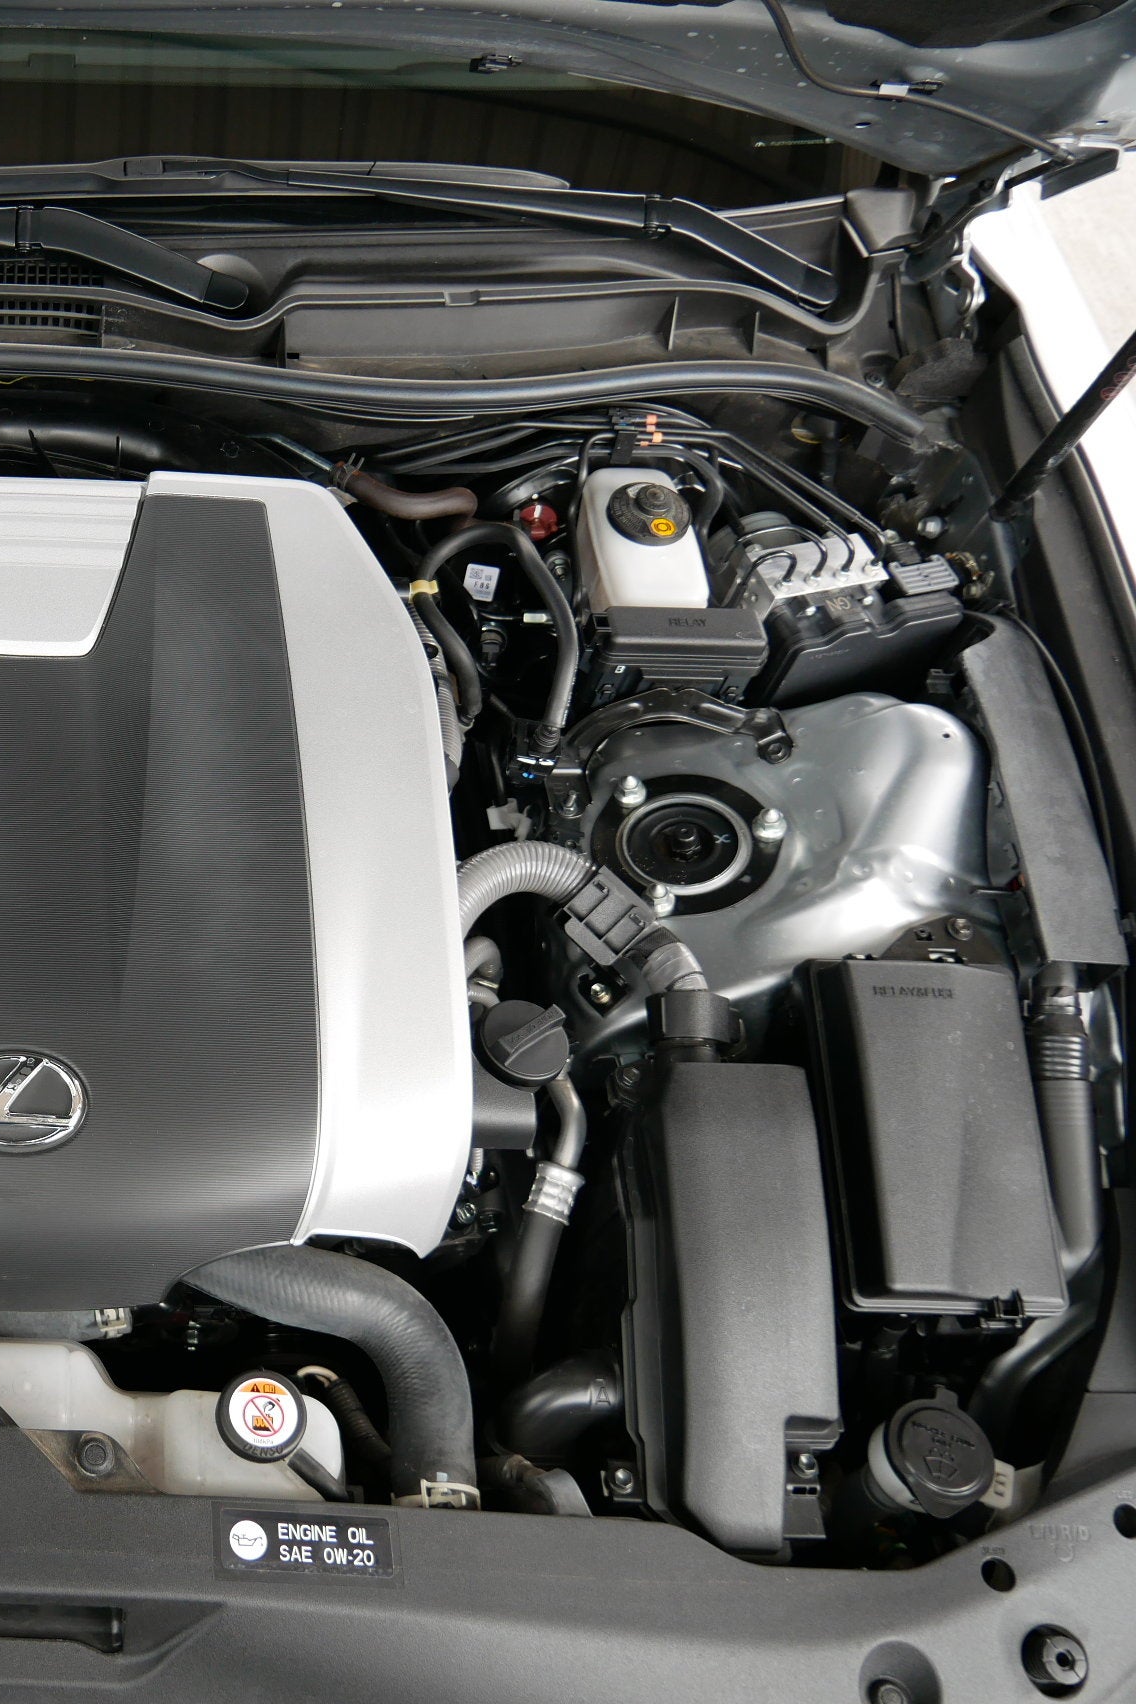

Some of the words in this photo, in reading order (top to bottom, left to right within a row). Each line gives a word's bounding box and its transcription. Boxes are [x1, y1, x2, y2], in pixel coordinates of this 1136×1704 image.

[243, 1443, 284, 1457] DENSO
[277, 1522, 337, 1543] ENGINE
[347, 1527, 374, 1545] OIL
[279, 1544, 313, 1563] SAE
[323, 1547, 375, 1566] 0W-20
